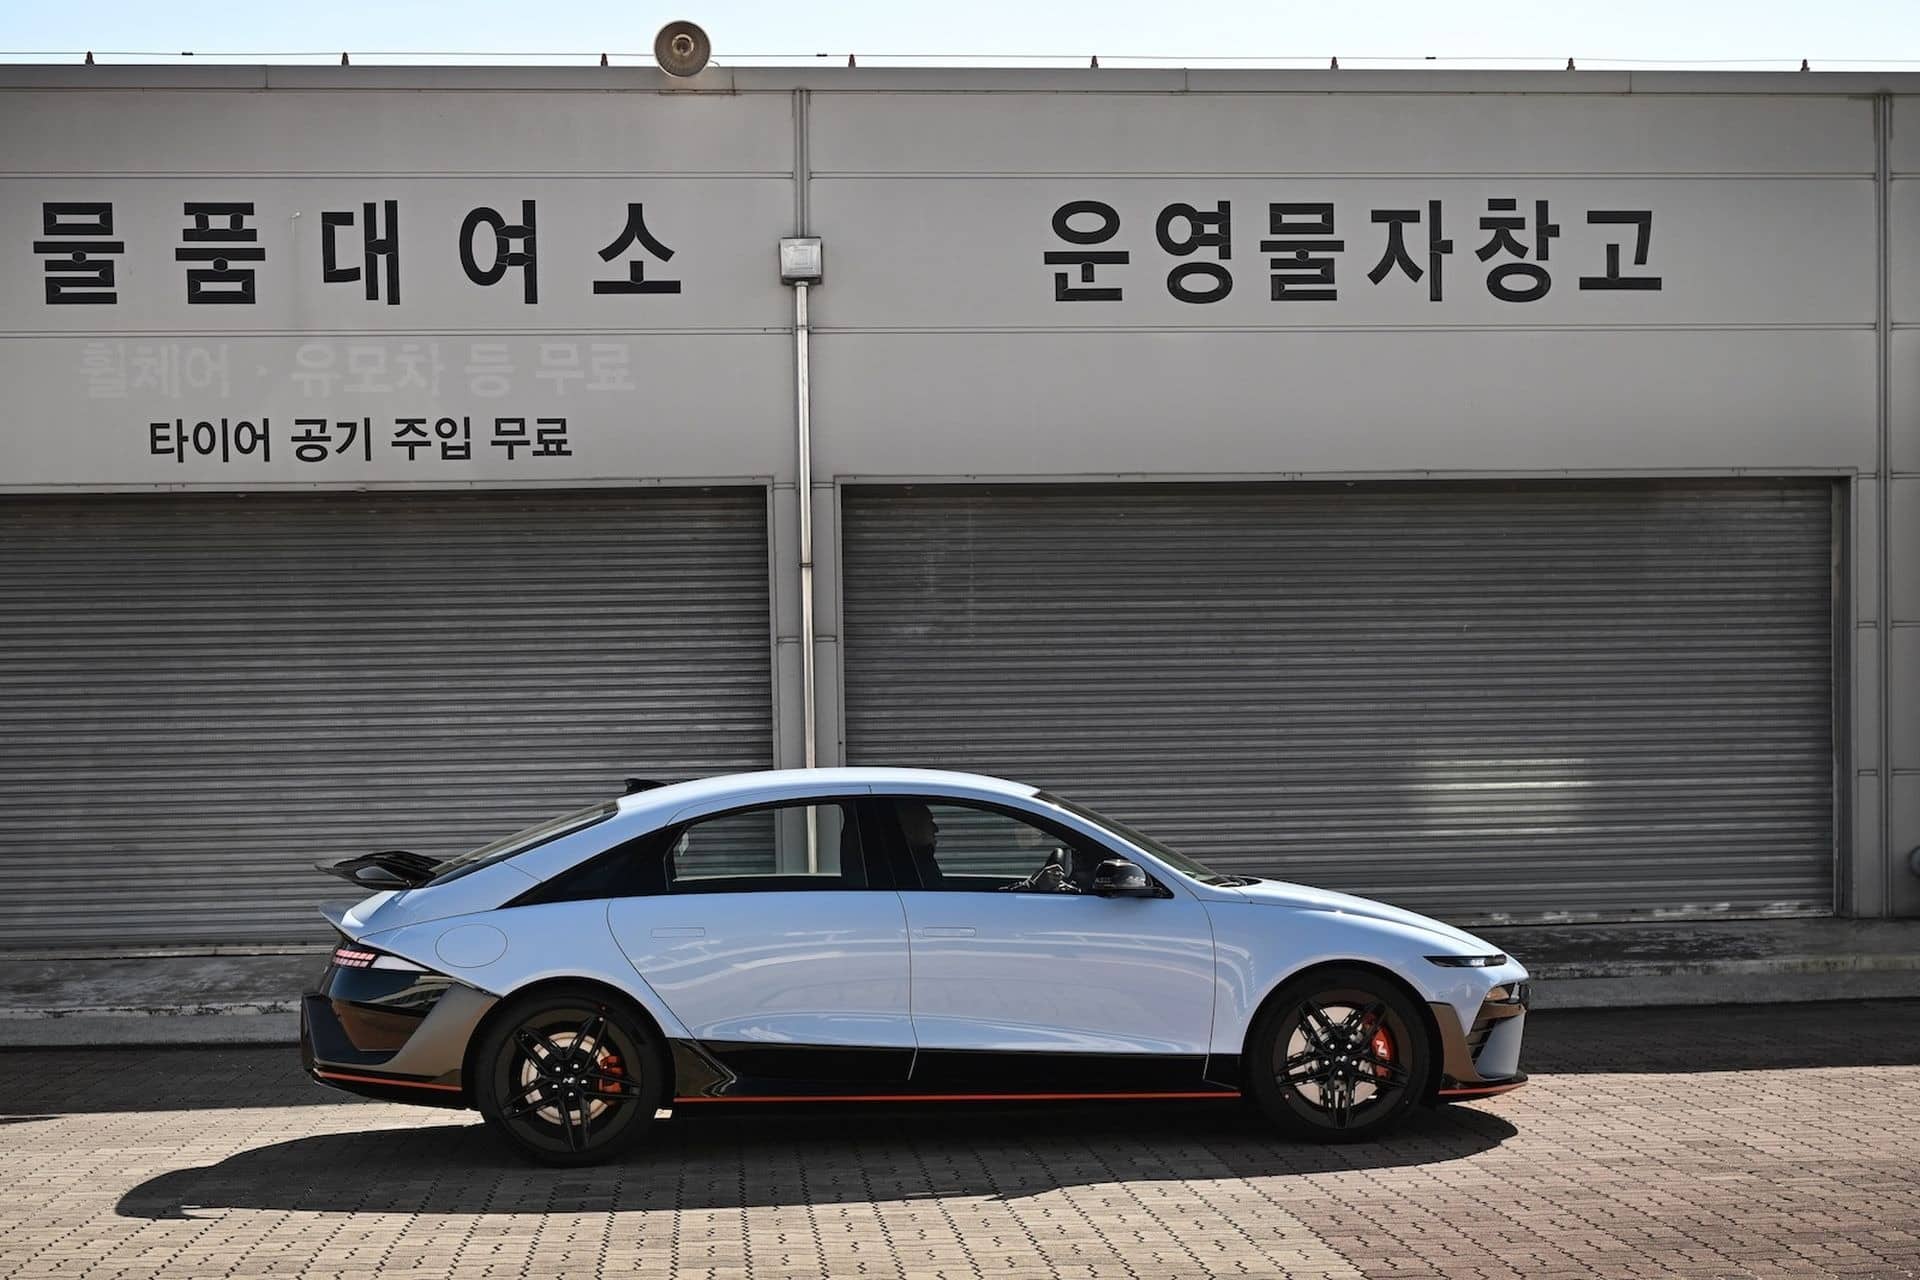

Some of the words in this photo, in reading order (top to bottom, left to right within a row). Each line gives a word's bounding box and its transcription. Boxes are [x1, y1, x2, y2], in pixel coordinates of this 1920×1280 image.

[1043, 199, 1662, 304] 운영물자창고
[290, 342, 446, 398] 유모차
[465, 343, 516, 398] 등
[536, 342, 637, 396] 무료
[151, 418, 271, 463] 타이어
[291, 418, 372, 462] 공기
[391, 417, 472, 461] 주입
[491, 418, 572, 460] 무료
